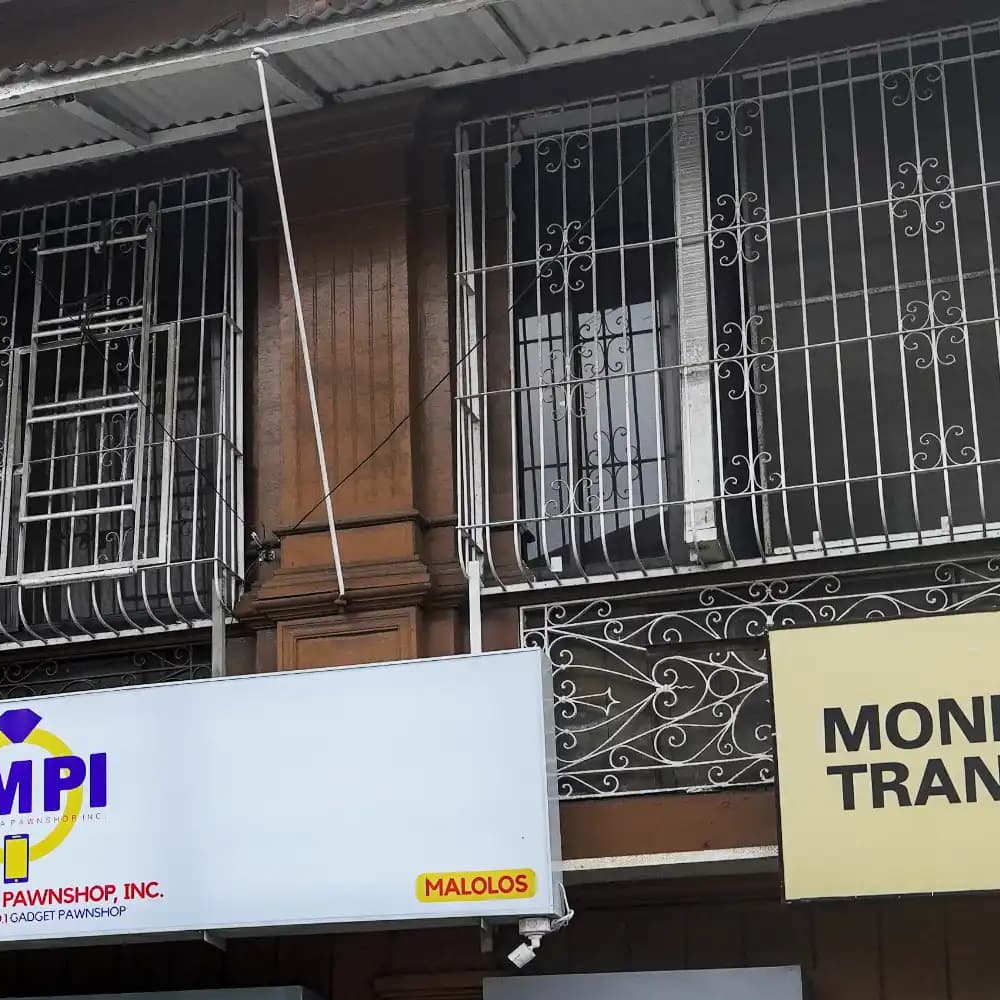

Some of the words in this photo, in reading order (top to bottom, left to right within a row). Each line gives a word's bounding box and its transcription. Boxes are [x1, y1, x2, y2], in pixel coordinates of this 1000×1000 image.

[824, 695, 1000, 753] MON
[827, 756, 1000, 810] TRAN
[11, 815, 76, 826] PAWNSHOP
[2, 884, 118, 908] PAWNSHOP,
[124, 882, 164, 900] INC.
[426, 874, 528, 896] MALOLOS
[10, 910, 55, 922] GADGET
[58, 906, 126, 920] PAWNSHOP
